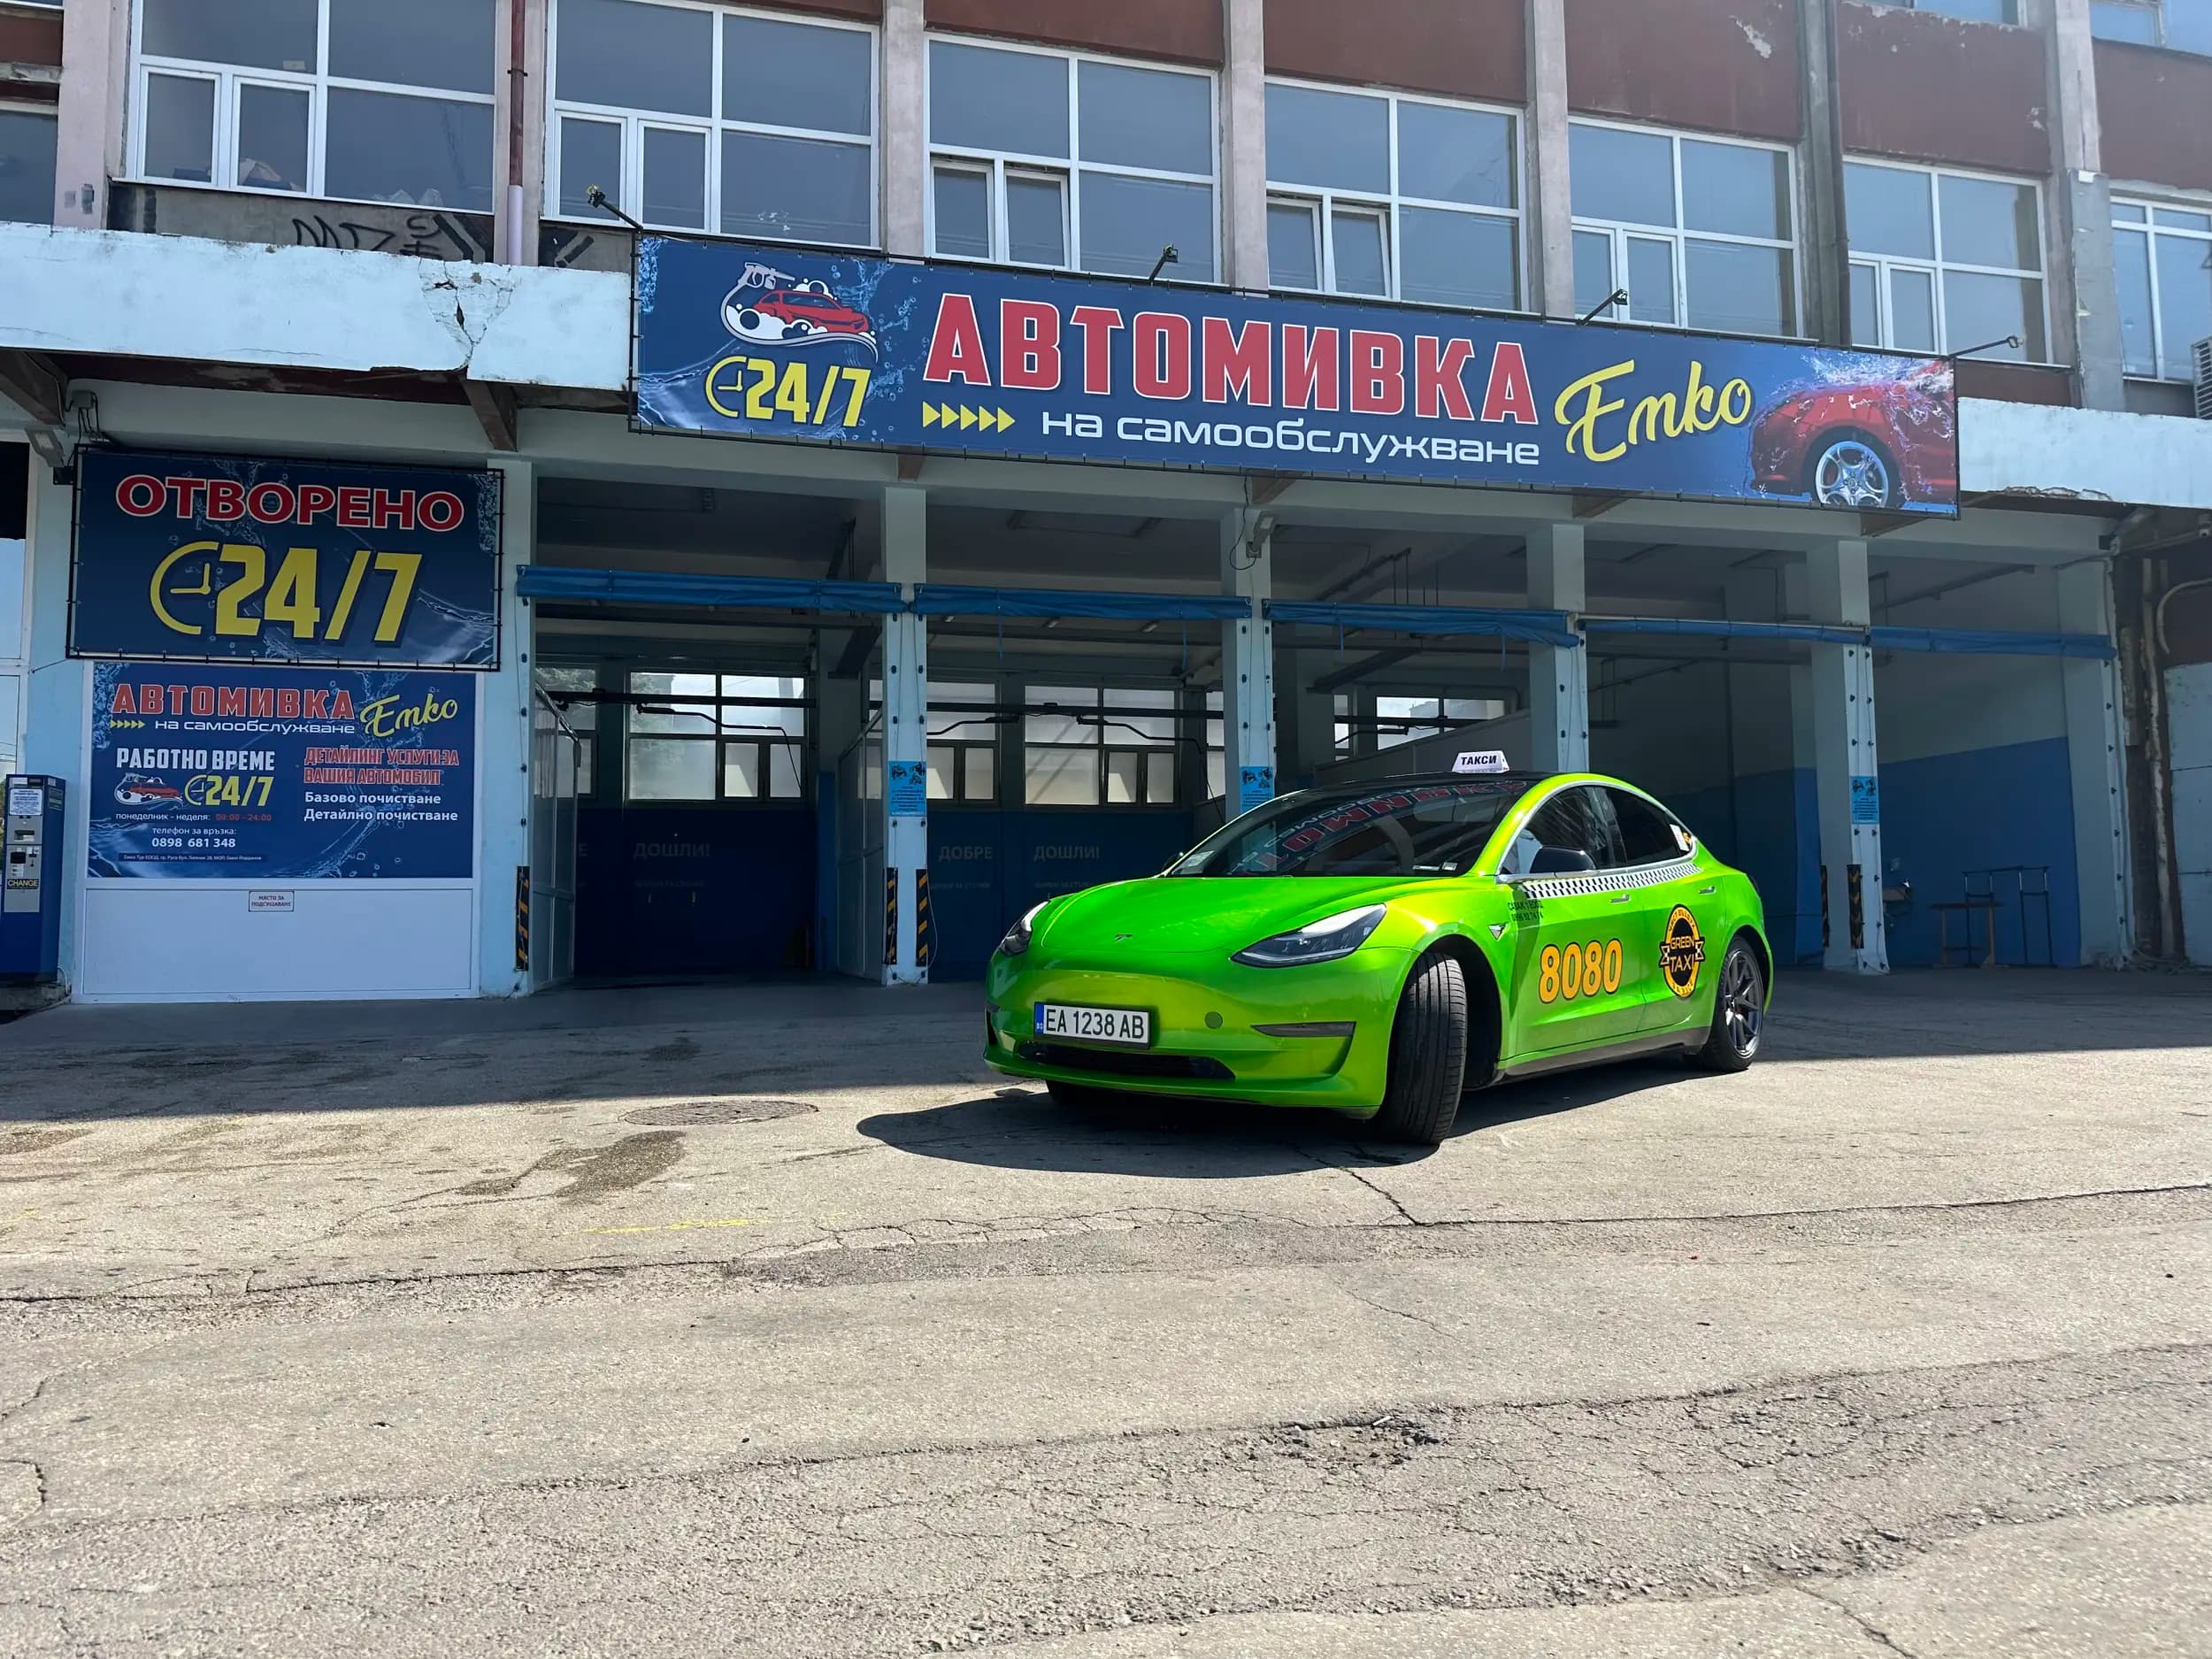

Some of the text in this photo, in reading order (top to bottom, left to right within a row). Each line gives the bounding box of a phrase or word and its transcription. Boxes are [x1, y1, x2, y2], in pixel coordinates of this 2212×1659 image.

[924, 293, 1539, 426] АВТОМИВКА
[744, 358, 872, 428] 24/7
[1042, 411, 1540, 465] на самообслужване
[116, 474, 465, 532] ОТВОРЕНО
[216, 543, 423, 642] 24/7
[111, 684, 355, 719] АВТОМИВКА
[155, 719, 355, 735] на самообслужване
[116, 748, 276, 771] РАБОТНО ВРЕМЕ
[304, 745, 459, 766] ДЕТАЙЛИНГ УСЛУГИ ЗА
[1461, 755, 1497, 765] ТАКСИ
[304, 767, 441, 785] ВАШИЯ АВТОМОБИЛ
[205, 775, 274, 807] 24/7
[304, 792, 441, 804] Базово почистване
[116, 813, 168, 822] понеделник
[177, 813, 211, 822] неделя:
[304, 808, 458, 822] Детайлно почистване
[152, 826, 189, 836] телефон
[204, 827, 237, 837] връзка:
[151, 837, 235, 848] 0898 681 348
[632, 842, 711, 860] ДОШЛИ!
[938, 845, 1100, 862] ДОБРЕ ДОШЛИ!
[7, 879, 39, 887] CHANGE
[1671, 936, 1694, 949] GREEN
[1539, 938, 1623, 1003] 8080
[1671, 955, 1694, 972] TAXI
[1046, 1009, 1067, 1033] EA
[1073, 1010, 1115, 1036] 1238
[1119, 1014, 1144, 1039] AB
